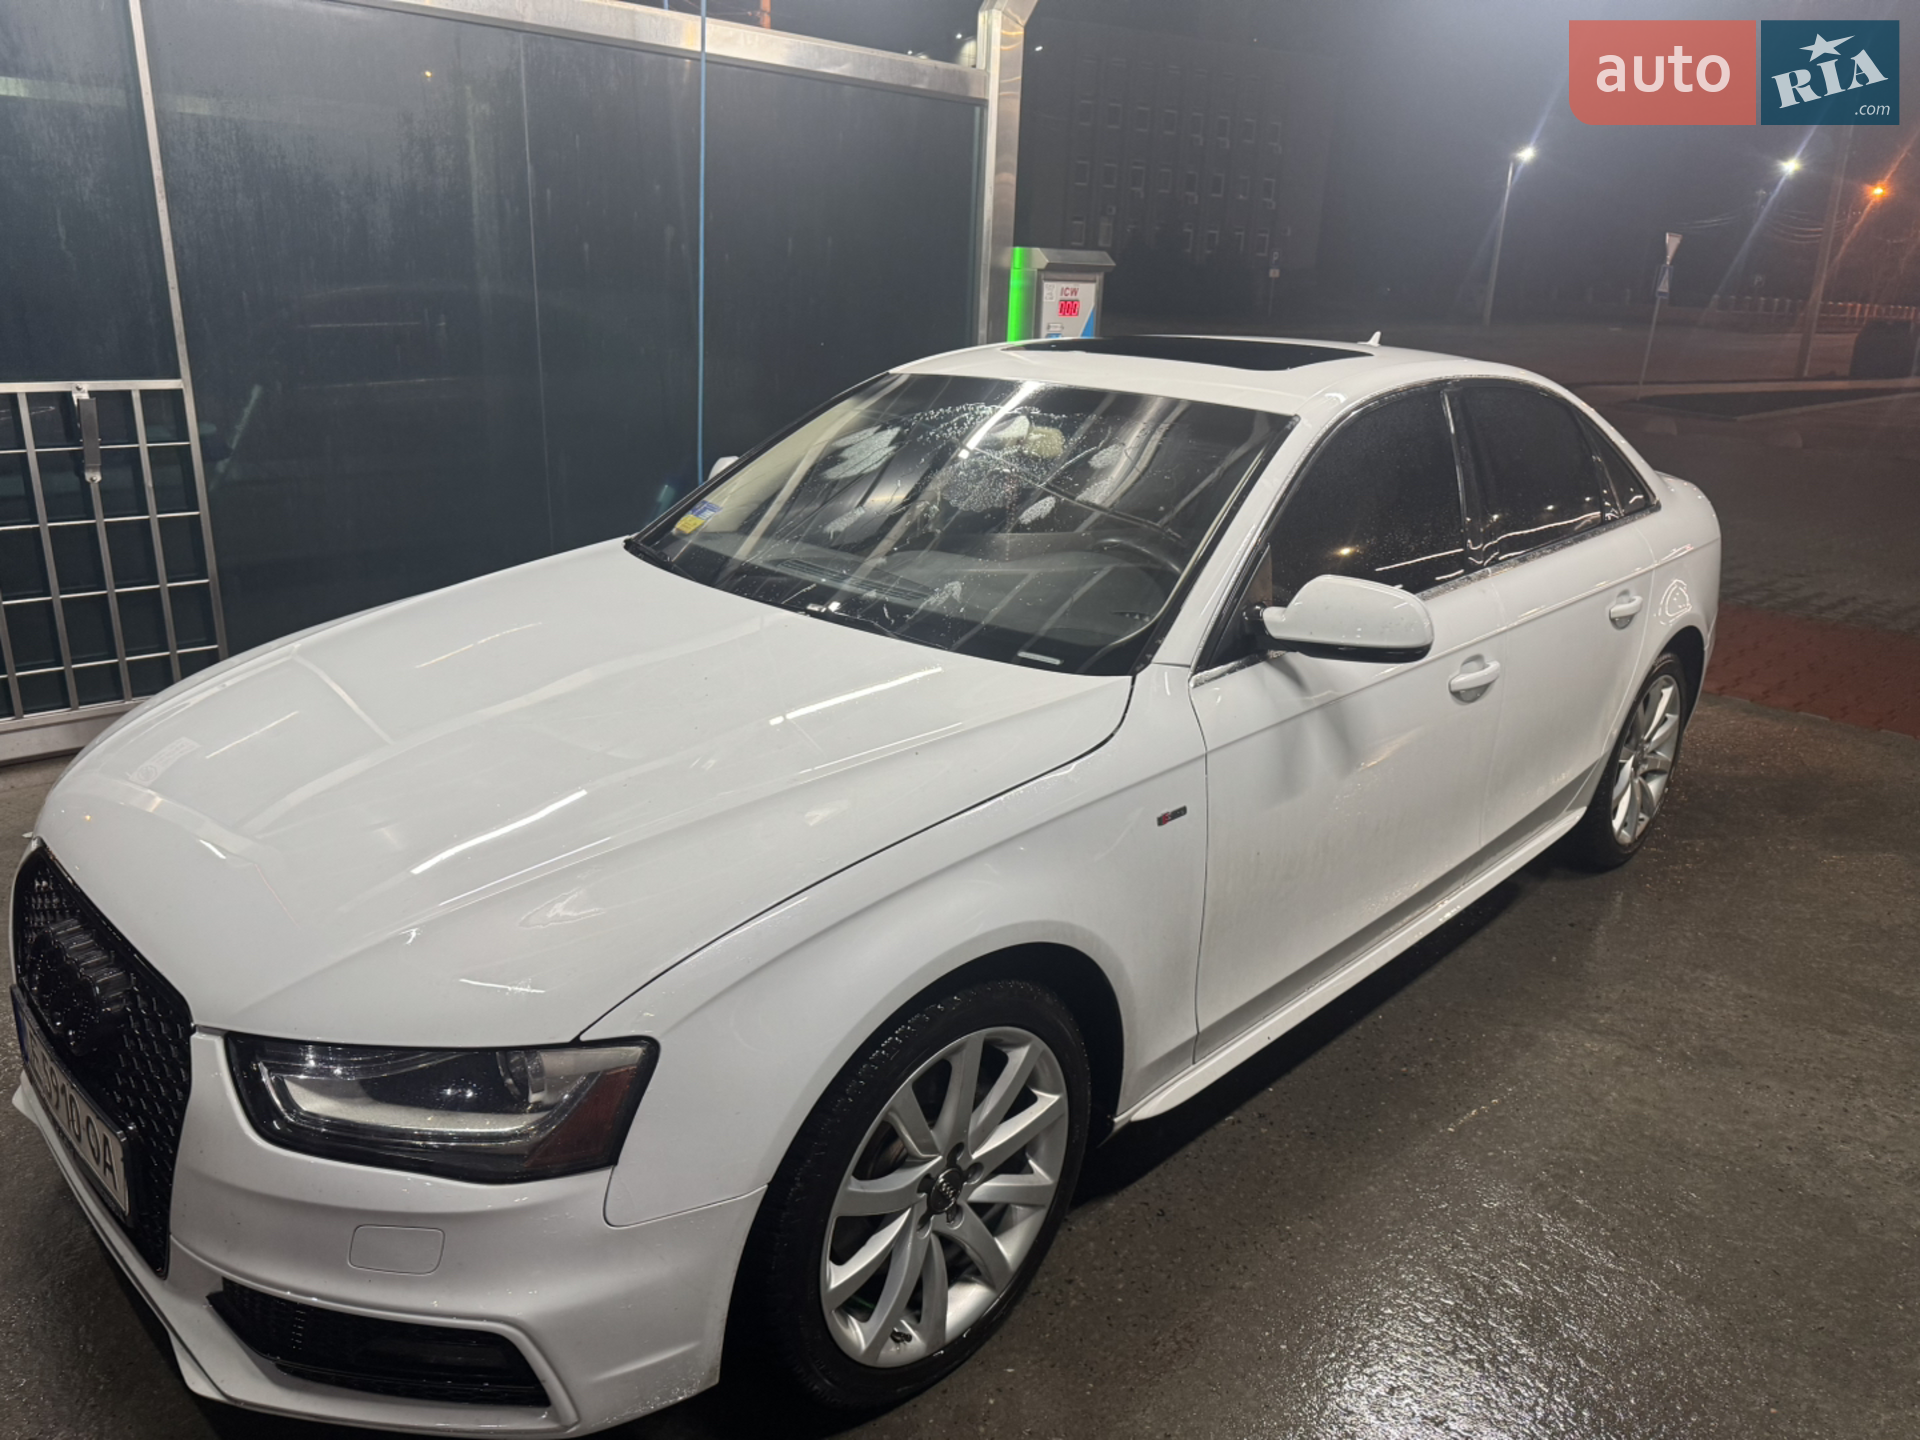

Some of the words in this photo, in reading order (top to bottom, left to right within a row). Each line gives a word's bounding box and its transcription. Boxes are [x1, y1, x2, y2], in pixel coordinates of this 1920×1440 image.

[1060, 287, 1079, 297] ICW
[1059, 300, 1080, 316] 000
[41, 1051, 82, 1143] 5910
[86, 1115, 118, 1191] OA
